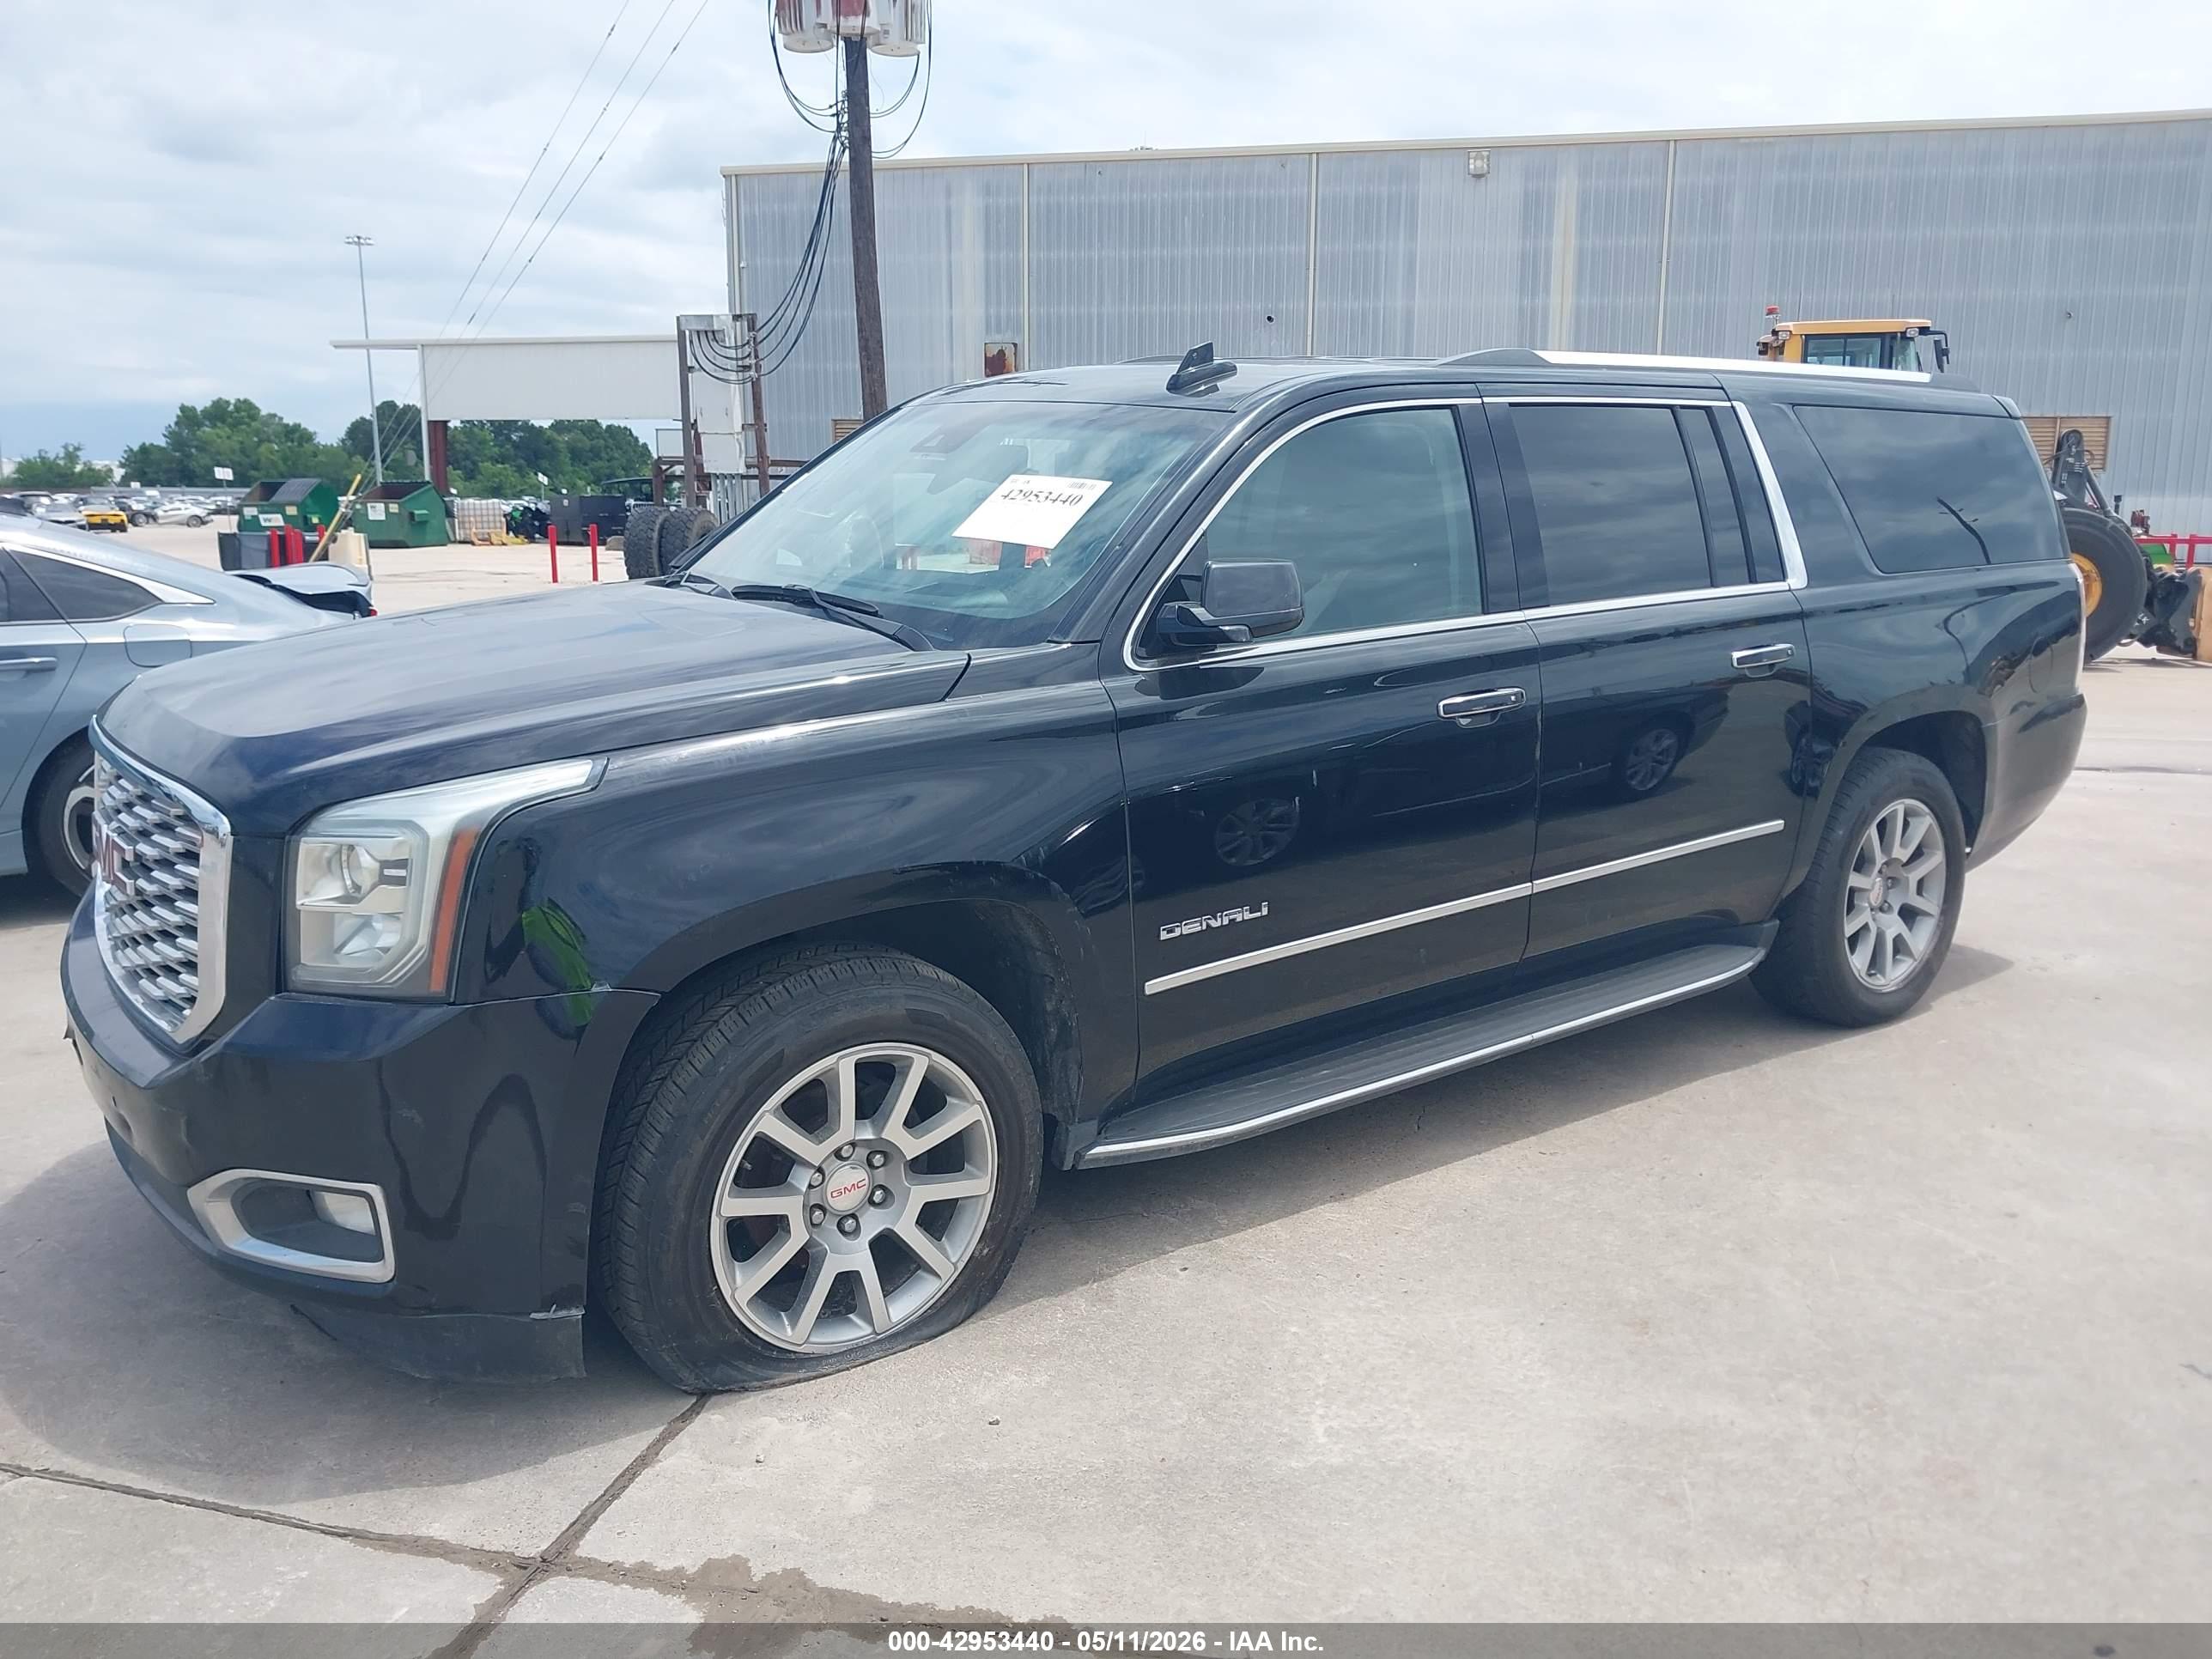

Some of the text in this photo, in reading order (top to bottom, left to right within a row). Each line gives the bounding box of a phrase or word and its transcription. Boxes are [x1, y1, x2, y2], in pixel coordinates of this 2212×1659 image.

[1001, 489, 1084, 507] 42953440
[1159, 902, 1269, 940] DENALI
[830, 1178, 867, 1199] GMC
